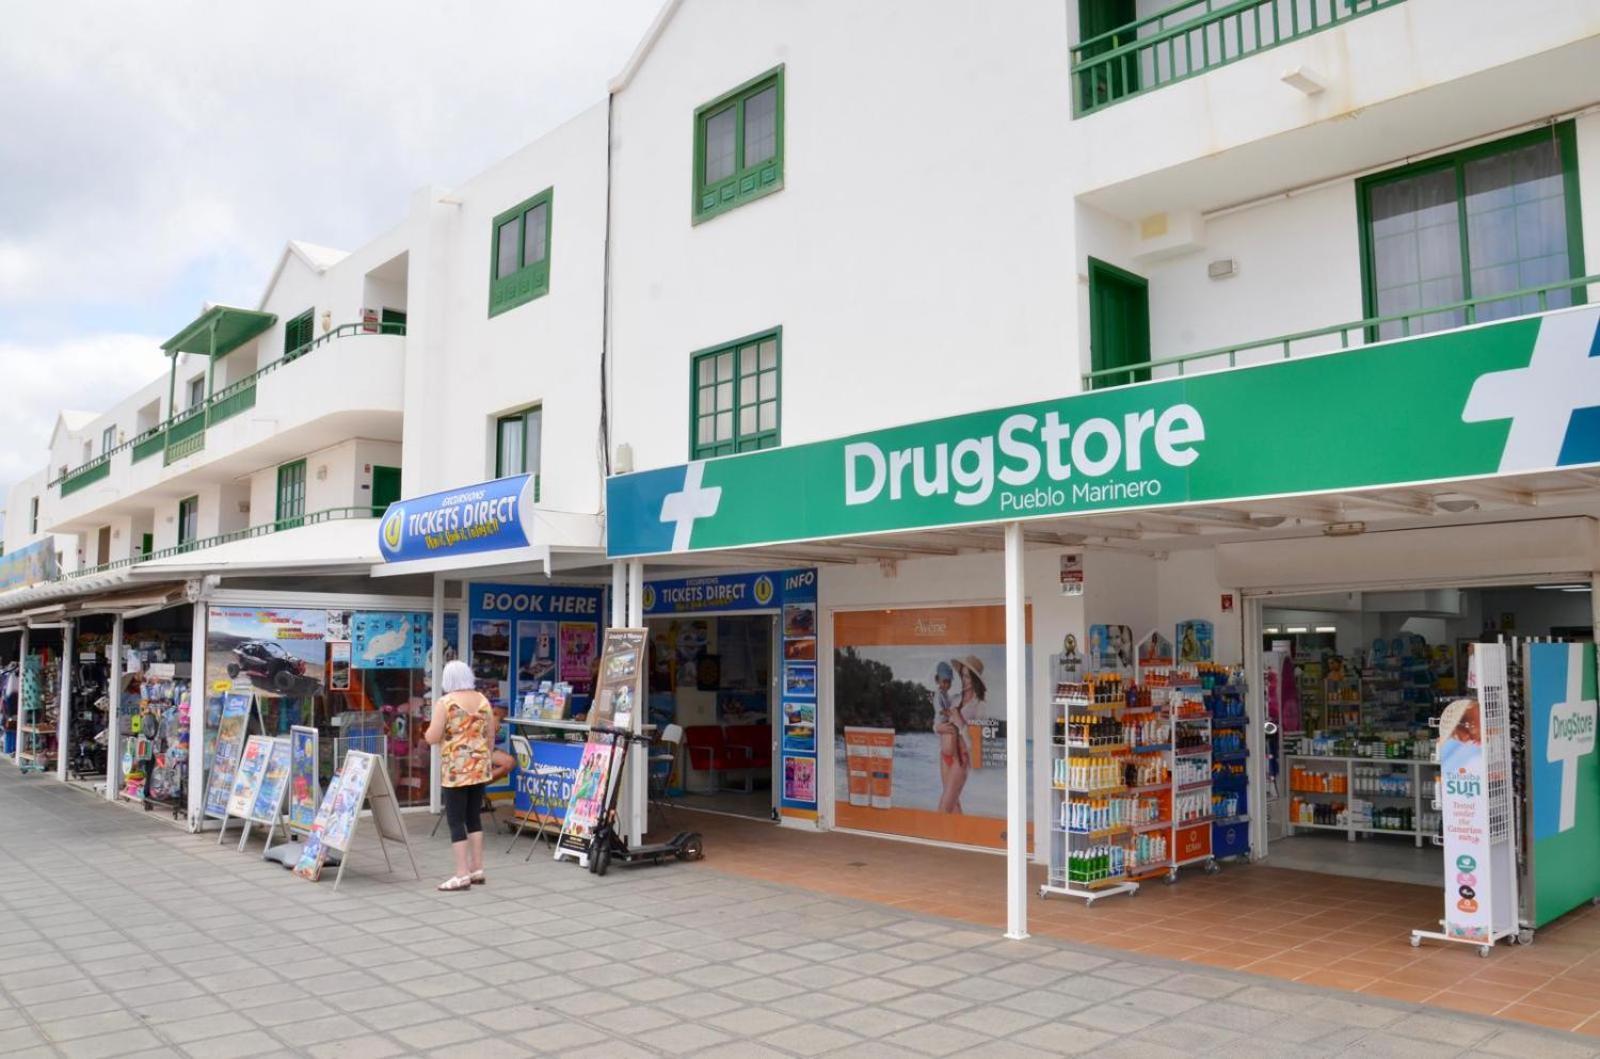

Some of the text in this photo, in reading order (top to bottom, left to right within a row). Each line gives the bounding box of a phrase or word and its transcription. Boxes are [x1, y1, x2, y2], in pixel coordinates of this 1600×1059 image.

[844, 403, 1205, 506] DrugStore
[1001, 477, 1161, 511] Pueblo Marinero
[409, 496, 517, 536] TICKETS DIRECT
[662, 583, 746, 603] TICKETS DIRECT
[785, 571, 814, 590] INFO
[482, 592, 597, 614] BOOK HERE
[1553, 712, 1592, 741] DrugStore
[1447, 780, 1481, 796] sun
